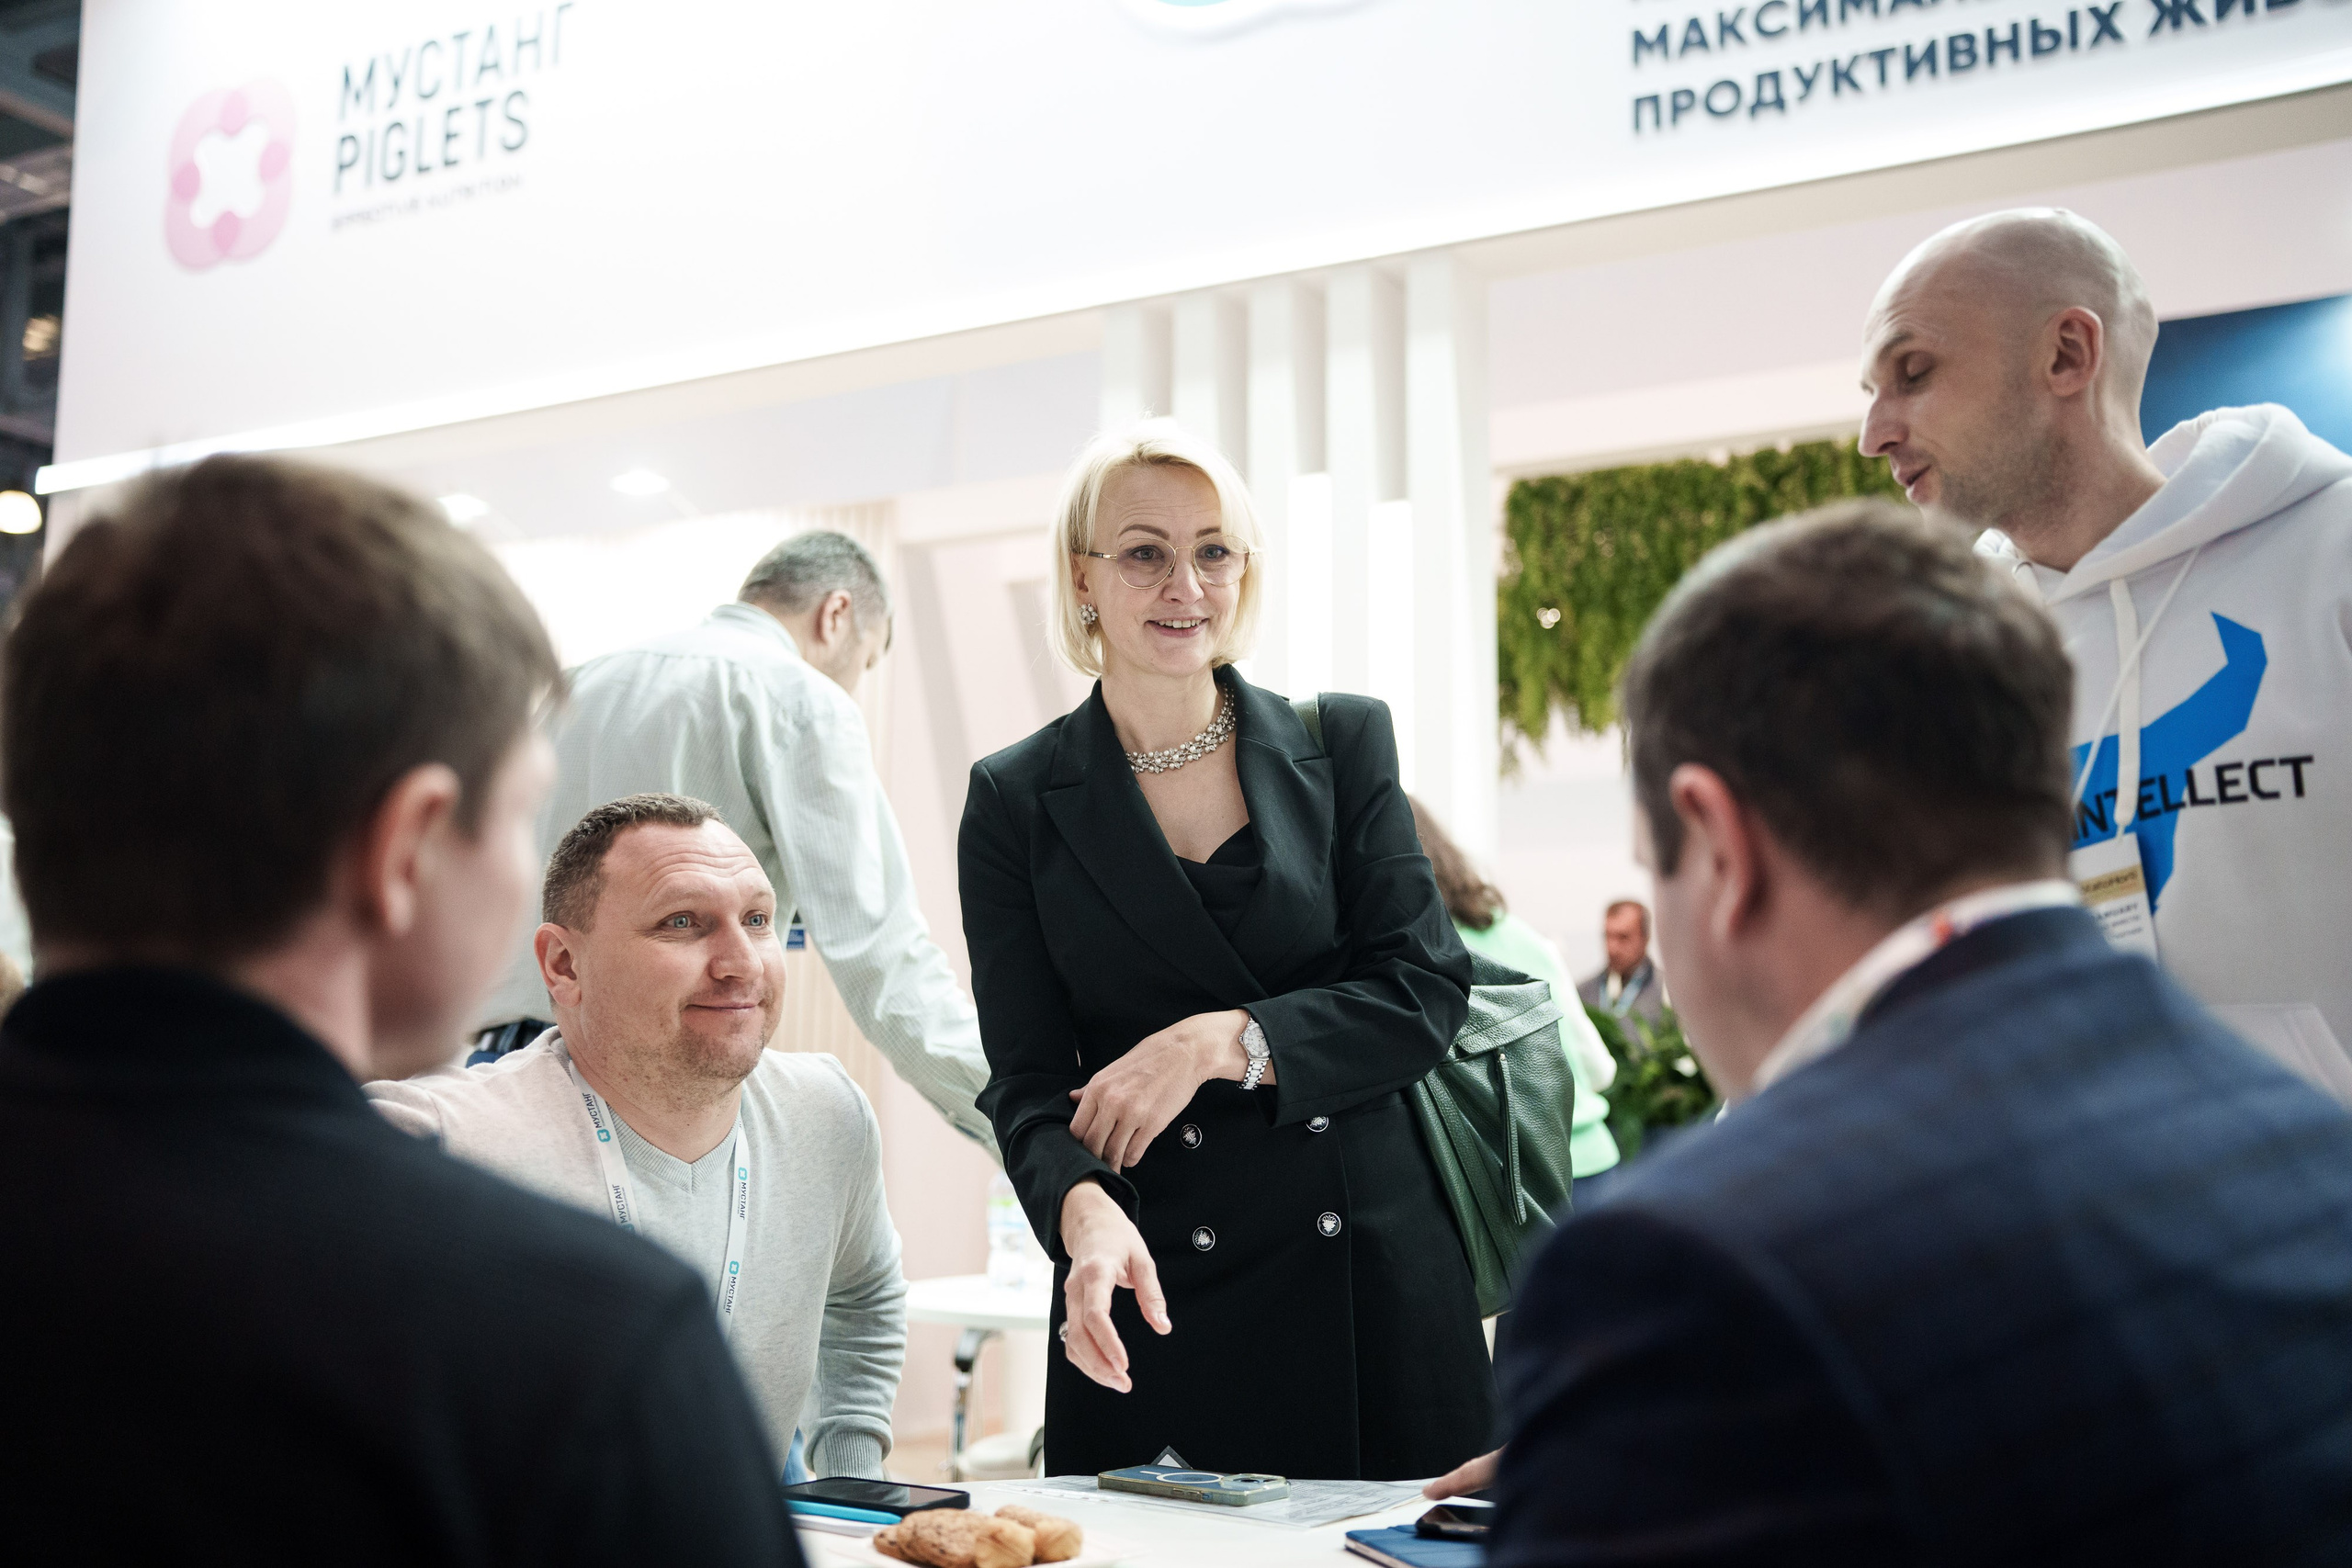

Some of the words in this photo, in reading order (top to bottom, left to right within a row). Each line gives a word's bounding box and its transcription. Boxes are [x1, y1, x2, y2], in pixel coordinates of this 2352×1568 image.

[338, 2, 575, 121] МУСТАНГ
[1633, 6, 2126, 134] ПРОДУКТИВНЫХ
[334, 90, 531, 195] PIGLETS
[582, 1092, 603, 1129] МУСТАНГ
[611, 1184, 628, 1224] МУСТАНГ
[739, 1181, 748, 1221] МУСТАНГ
[725, 1276, 737, 1316] МУСТАНГ
